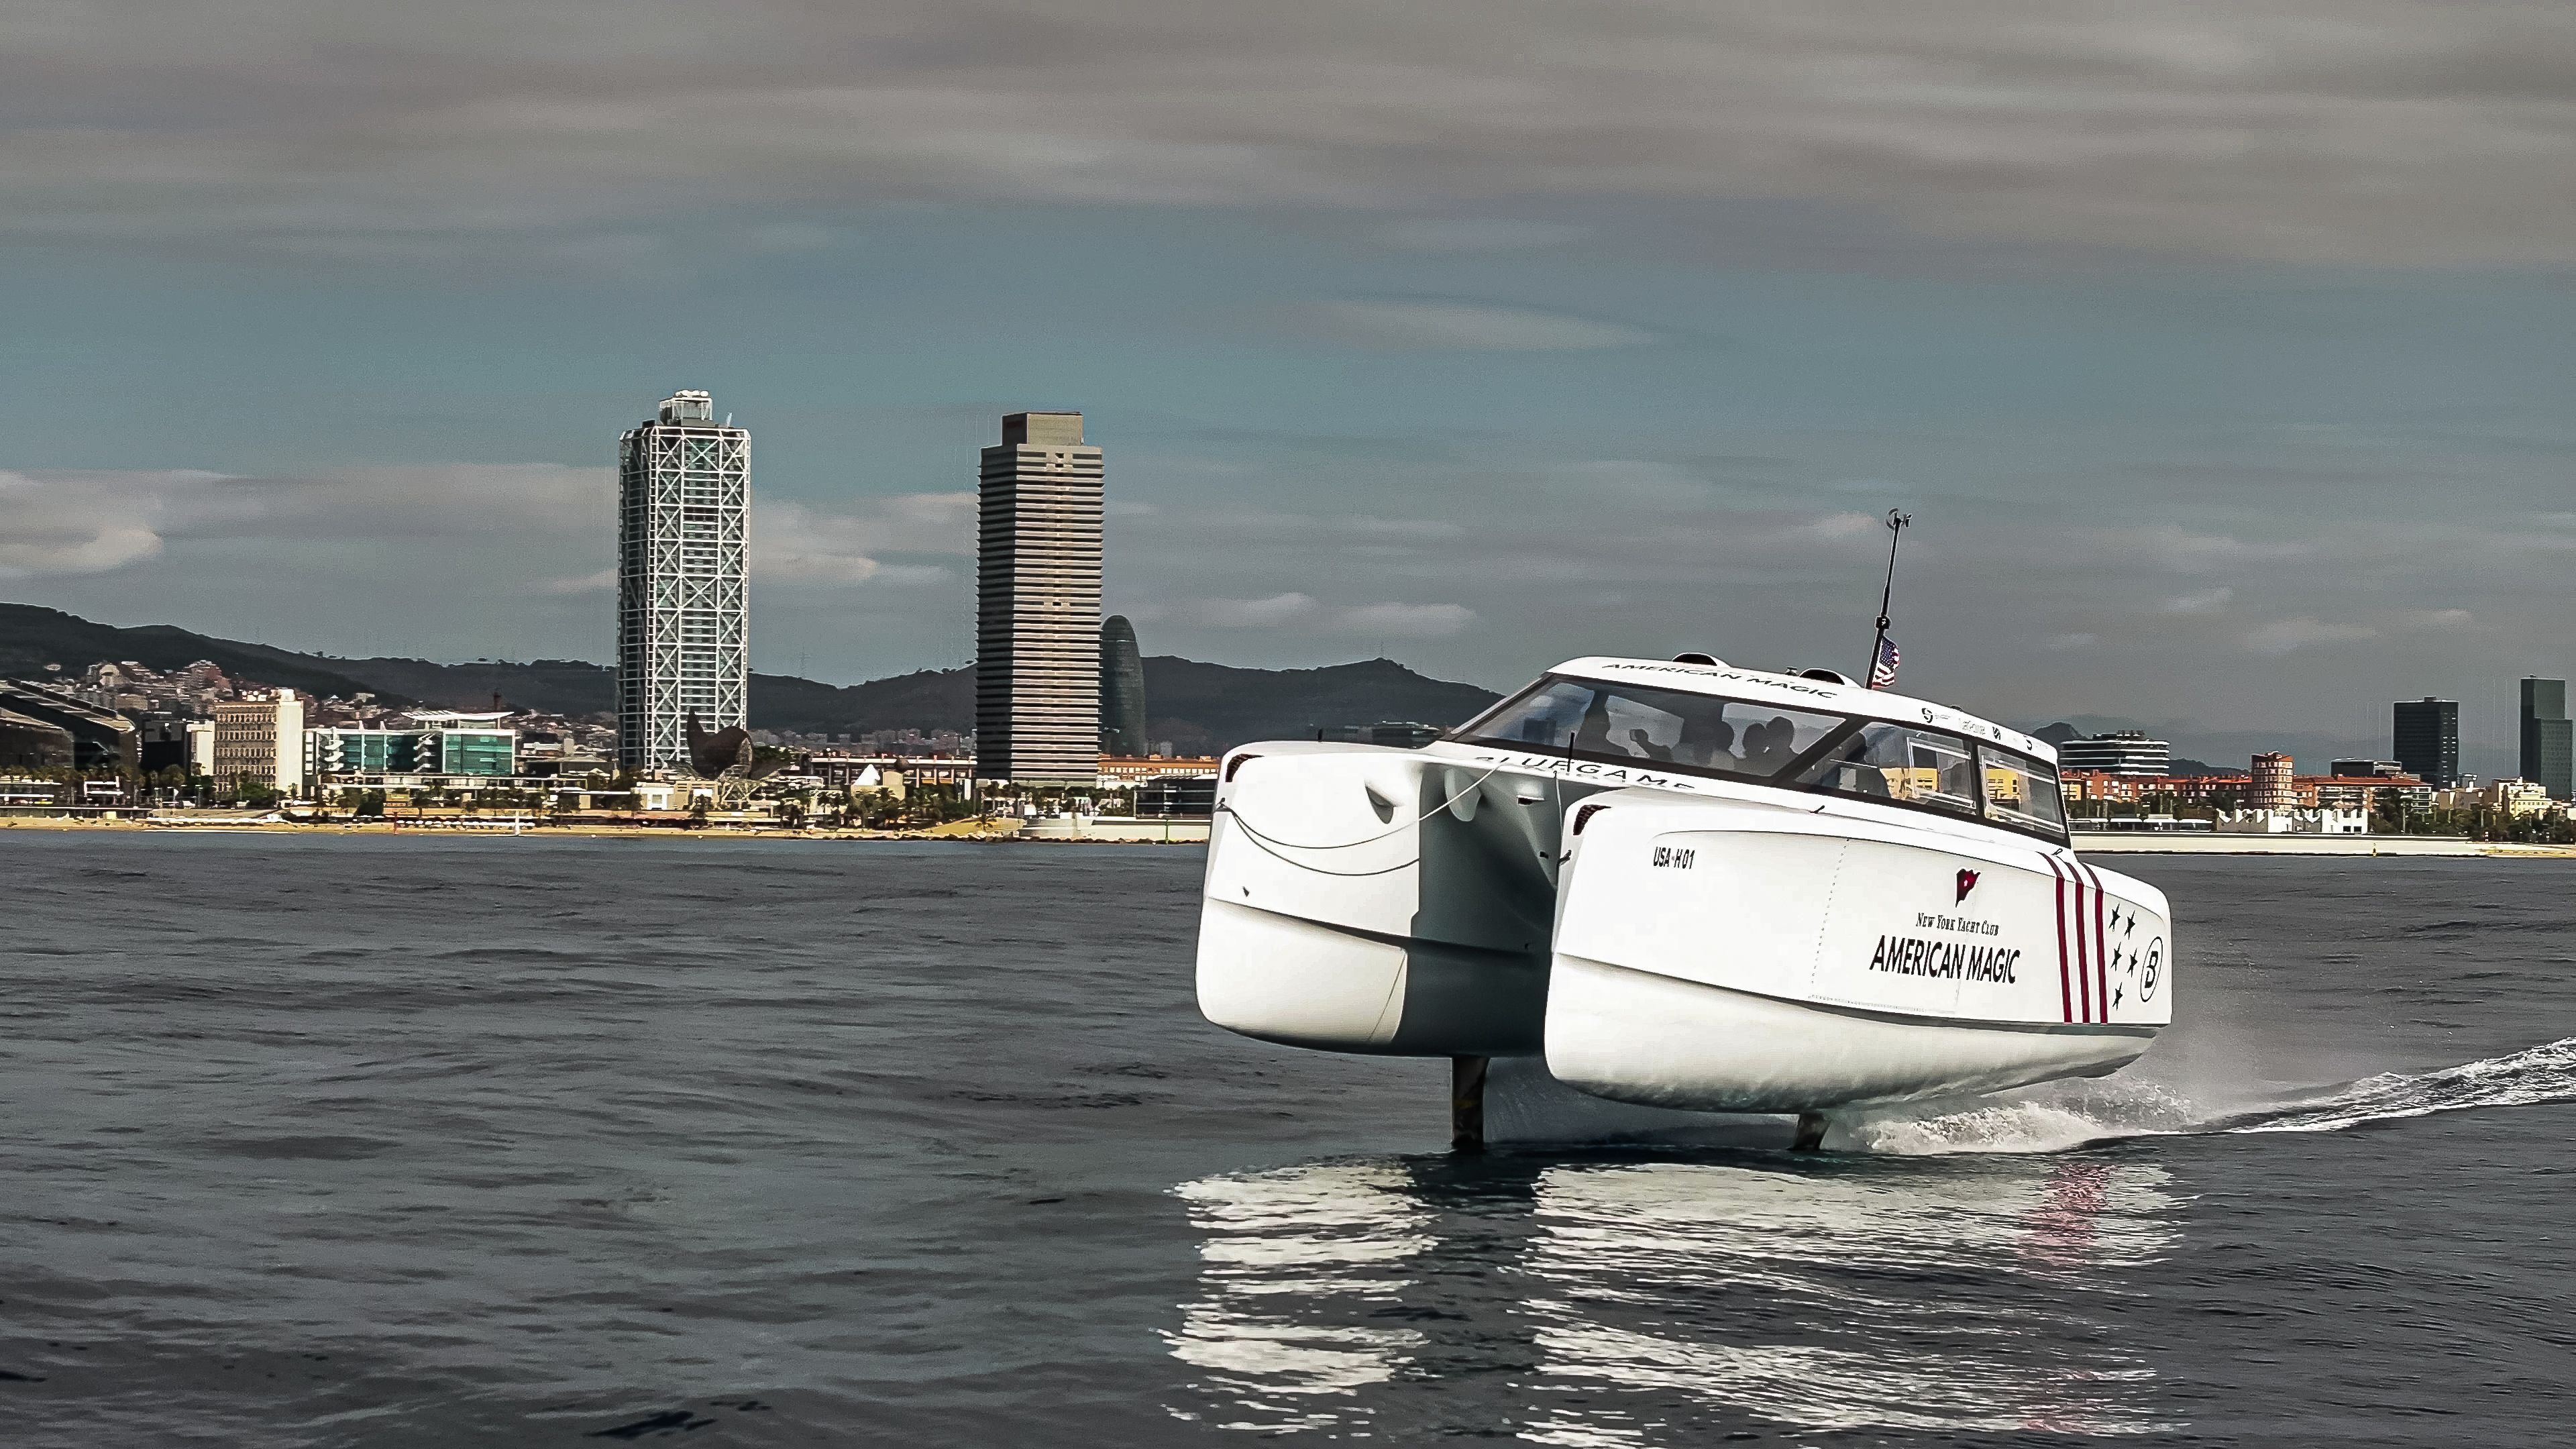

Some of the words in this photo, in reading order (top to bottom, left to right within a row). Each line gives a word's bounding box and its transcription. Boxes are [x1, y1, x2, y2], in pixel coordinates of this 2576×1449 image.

[1601, 664, 1742, 680] AMERICAN
[1746, 678, 1838, 698] MAGIC
[1474, 757, 1695, 789] UEGAM
[1868, 934, 1966, 979] AMERICAN
[1966, 945, 2021, 984] MAGIC
[2144, 950, 2159, 989] B
